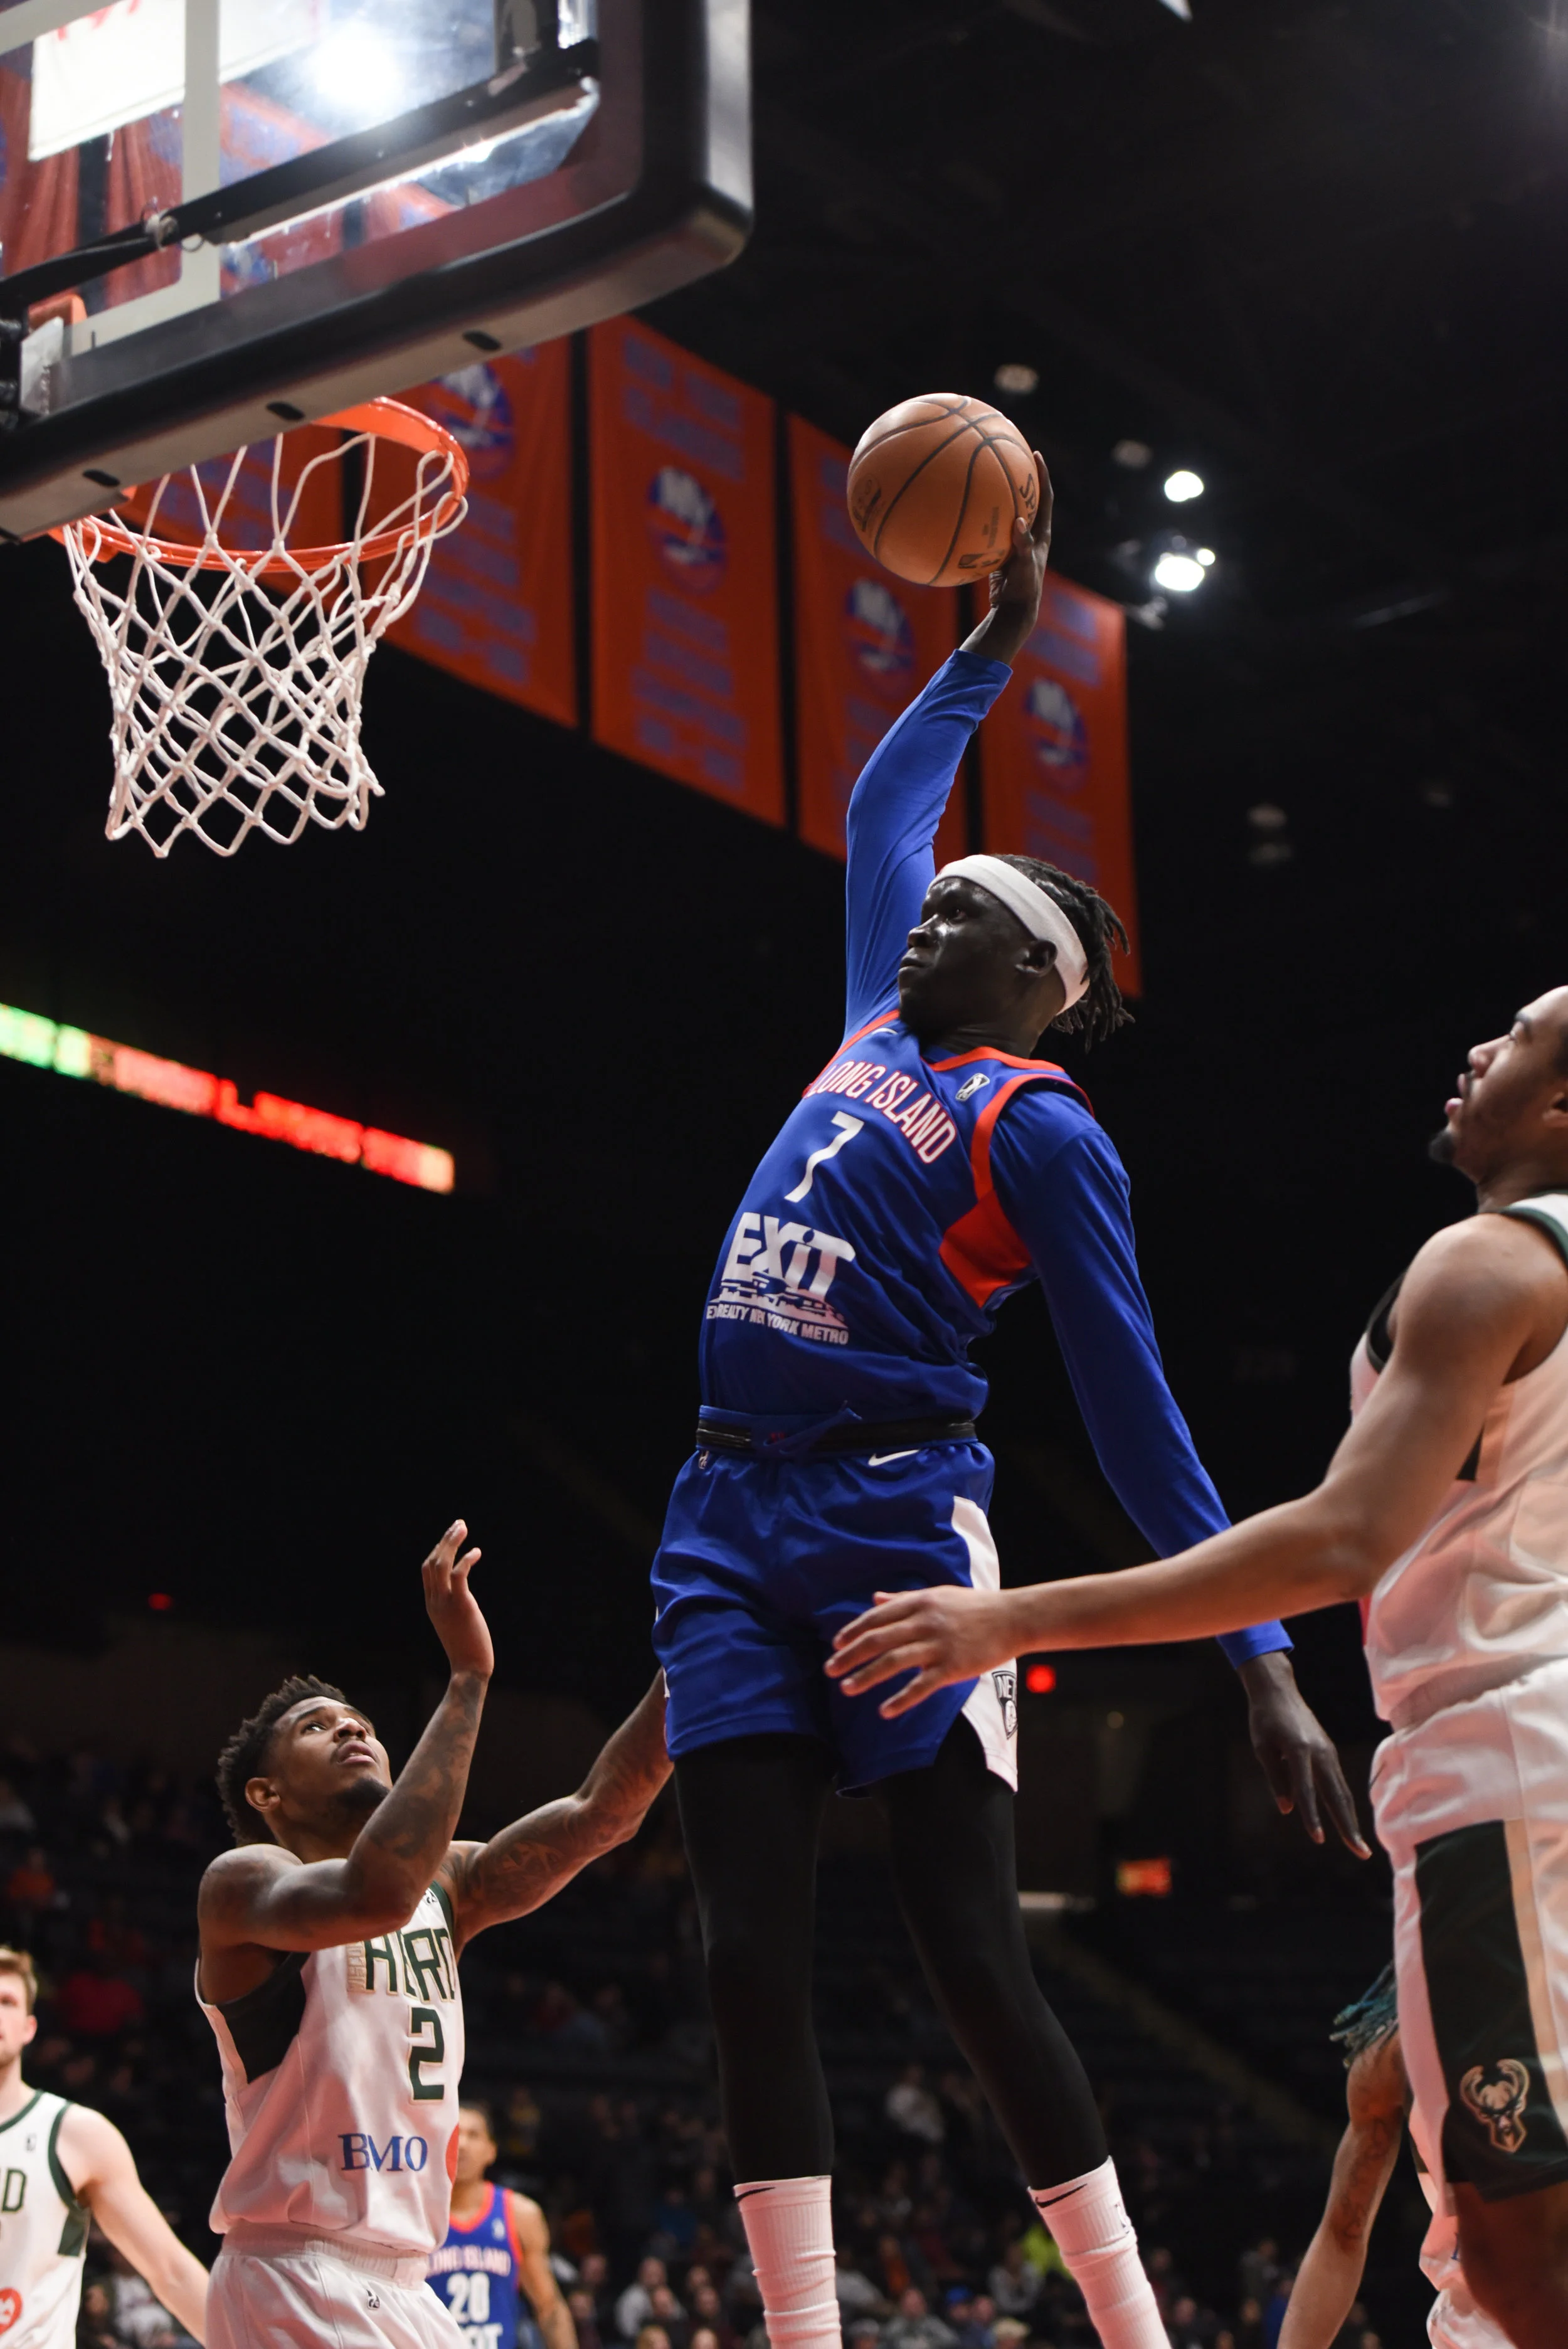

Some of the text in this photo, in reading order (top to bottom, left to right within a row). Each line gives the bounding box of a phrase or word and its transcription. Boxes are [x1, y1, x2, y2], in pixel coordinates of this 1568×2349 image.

[864, 1070, 957, 1164] ISLAND
[784, 1111, 865, 1202] 7
[766, 1312, 799, 1335] YORK
[800, 1322, 849, 1345] METRO
[408, 2007, 445, 2104] 2
[339, 2133, 428, 2173] BMO
[447, 2272, 490, 2323] 20
